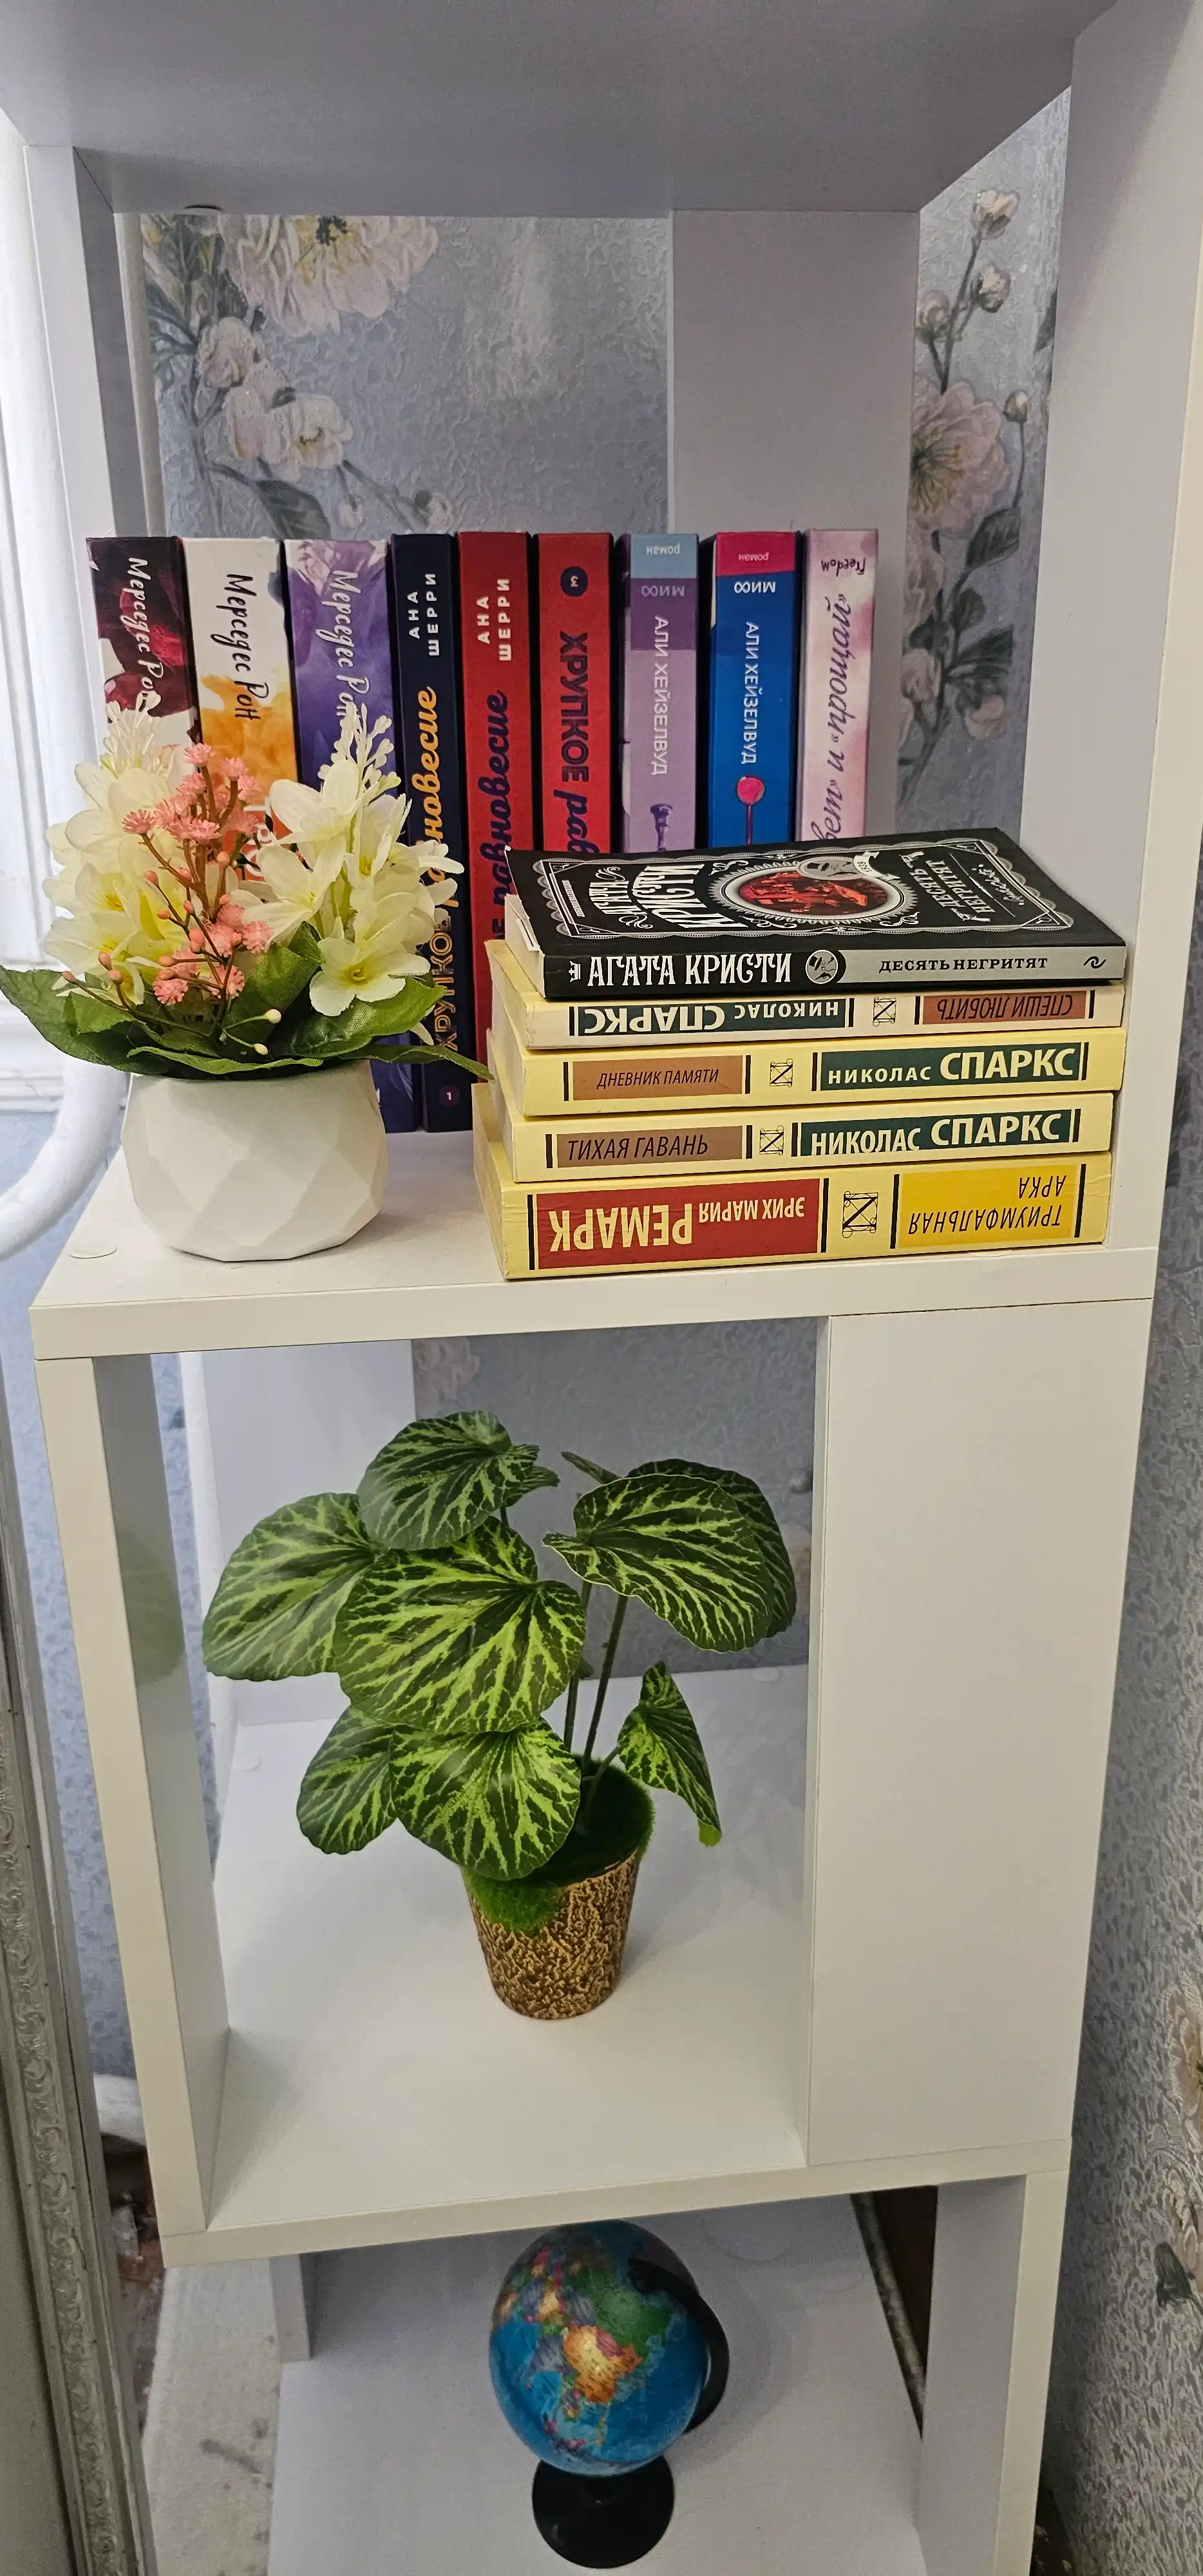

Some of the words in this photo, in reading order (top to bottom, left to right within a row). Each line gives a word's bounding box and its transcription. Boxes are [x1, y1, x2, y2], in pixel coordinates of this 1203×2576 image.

[647, 545, 681, 556] роман
[738, 553, 770, 562] роман
[570, 575, 578, 588] 3
[120, 557, 151, 653] Мерседес
[316, 569, 361, 668] Мерседес
[407, 591, 421, 639] АНА
[425, 574, 440, 656] ШЕРРИ
[477, 596, 490, 644] АНА
[497, 579, 512, 661] ШЕРРИ
[211, 574, 258, 673] Мерседес
[654, 616, 668, 658] АЛИ
[744, 621, 760, 660] АЛИ
[234, 682, 269, 721] Рон
[560, 631, 589, 782] ХРУПКОЕ
[651, 663, 670, 775] ХЕЙЗЕЛВУД
[741, 664, 763, 764] ХЕЙЗЕЛВУД
[828, 750, 845, 773] и
[589, 880, 641, 915] АГАТА
[632, 864, 749, 929] КРИСТИ
[909, 869, 966, 907] ДЕСЯТЬ
[925, 860, 996, 913] НЕГРИТЯТ
[587, 956, 676, 987] АГАТА
[685, 953, 792, 985] КРИСТИ
[879, 960, 950, 974] ДЕСЯТЬ
[953, 957, 1048, 970] НЕГРИТЯТ
[583, 1005, 725, 1034] СПАРКС
[734, 1001, 838, 1019] НИКОЛАС
[937, 998, 1009, 1020] ЛЮБИТЬ
[1012, 994, 1073, 1018] СПЕШИ
[596, 1072, 662, 1089] ДНЕВНИК
[663, 1069, 719, 1084] ПАМЯТИ
[828, 1066, 931, 1084] НИКОЛАС
[940, 1048, 1075, 1080] СПАРКС
[446, 1092, 452, 1101] 1
[568, 1139, 629, 1161] ТИХАЯ
[634, 1135, 708, 1158] ГАВАНЬ
[811, 1128, 921, 1157] НИКОЛАС
[931, 1113, 1061, 1146] СПАРКС
[1019, 1175, 1067, 1198] АРКА
[699, 1199, 757, 1222] МАРИЯ
[763, 1197, 805, 1219] ЭРИХ
[908, 1205, 1062, 1235] ТРИУМФАЛЬНАЯ
[548, 1203, 694, 1253] РЕМАРК
